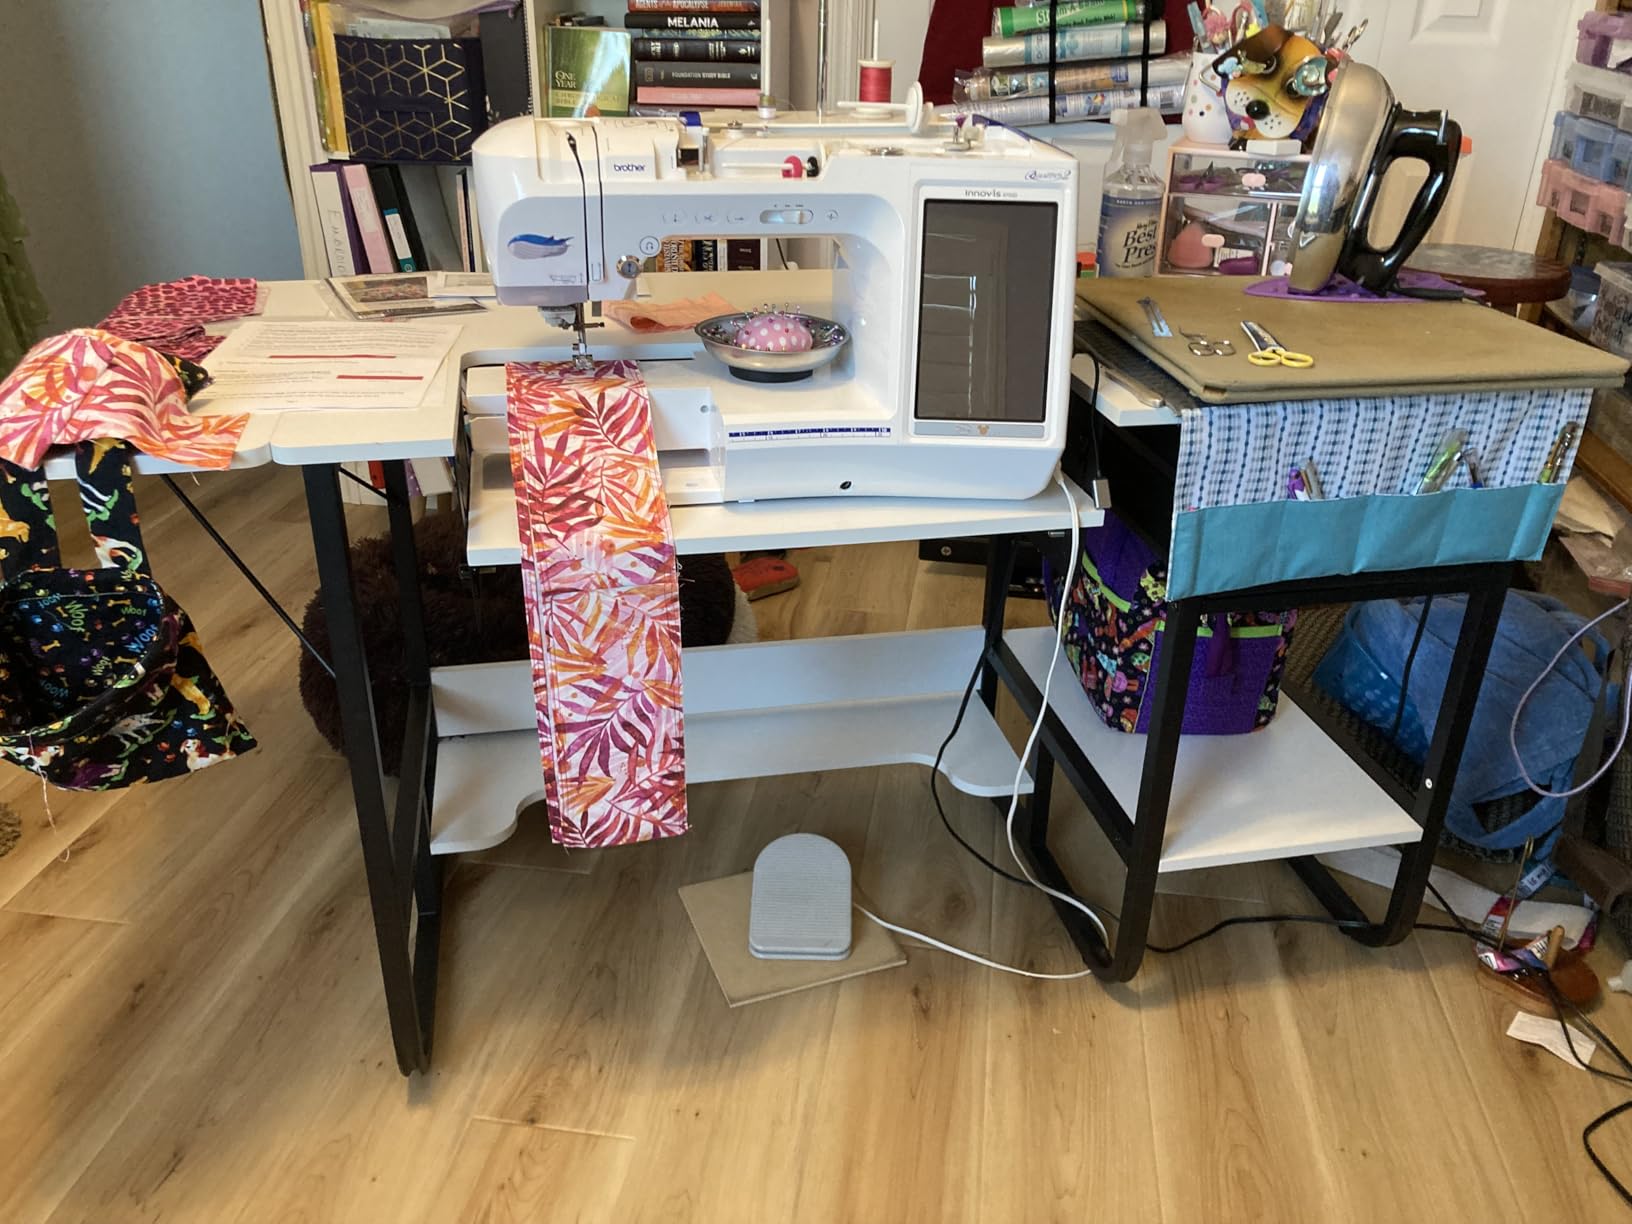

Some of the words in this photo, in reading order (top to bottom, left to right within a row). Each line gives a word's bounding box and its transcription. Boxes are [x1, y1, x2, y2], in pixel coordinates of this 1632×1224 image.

[667, 17, 719, 28] MELANIA
[555, 70, 576, 81] ONE
[555, 80, 577, 89] YEAR
[613, 163, 646, 172] brother
[1124, 225, 1158, 248] Best
[1123, 244, 1156, 263] Pre
[64, 600, 88, 632] Woof
[124, 624, 159, 653] Woof
